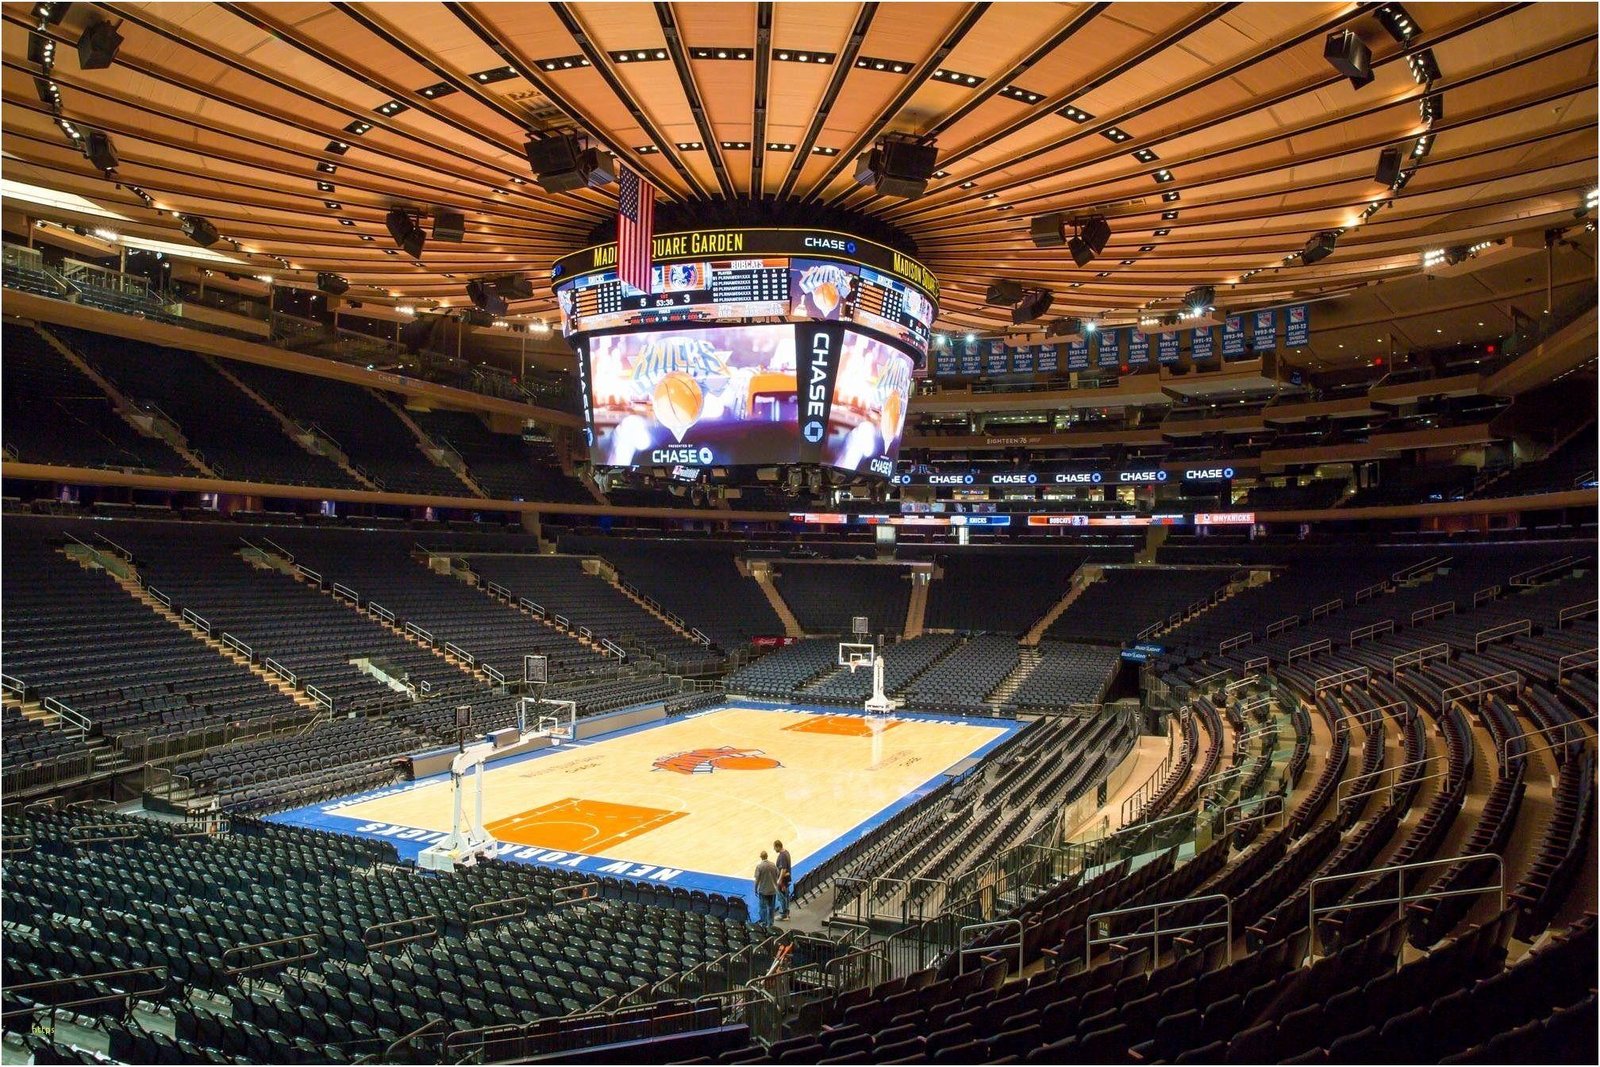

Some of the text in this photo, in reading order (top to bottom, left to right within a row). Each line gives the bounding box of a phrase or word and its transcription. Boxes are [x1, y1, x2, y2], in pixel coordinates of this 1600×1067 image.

[652, 236, 688, 258] QUARE
[691, 233, 743, 254] GARDEN
[804, 237, 846, 251] CHASE
[731, 259, 764, 269] BOBCATS
[893, 252, 922, 284] MADISON
[640, 298, 647, 307] 5
[683, 293, 690, 303] 3
[806, 332, 830, 418] CHASE
[652, 449, 698, 463] CHASE
[992, 474, 1026, 484] CHASE
[1056, 474, 1090, 482] CHASE
[1120, 472, 1156, 481] CHASE
[1186, 469, 1222, 479] CHASE
[929, 475, 964, 484] CHASE
[356, 823, 449, 844] ICKS
[597, 861, 685, 882] NEW
